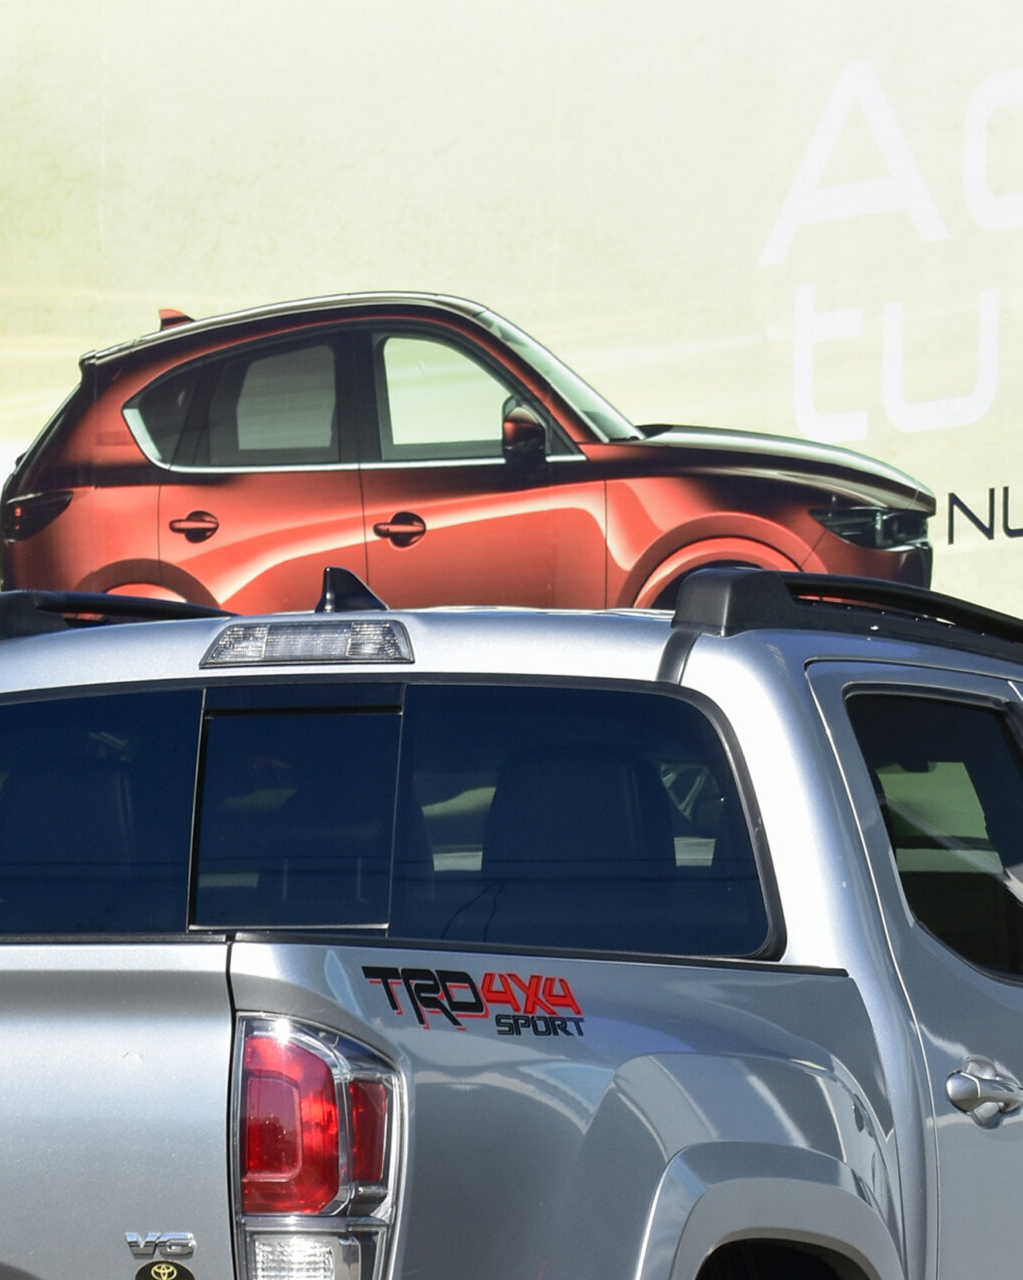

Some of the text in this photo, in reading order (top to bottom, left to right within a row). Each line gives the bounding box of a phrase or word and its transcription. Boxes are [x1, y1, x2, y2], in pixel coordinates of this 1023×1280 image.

[793, 283, 1001, 443] tu
[362, 966, 489, 1031] TRD
[495, 1014, 585, 1037] SPORT
[125, 1231, 197, 1260] V6
